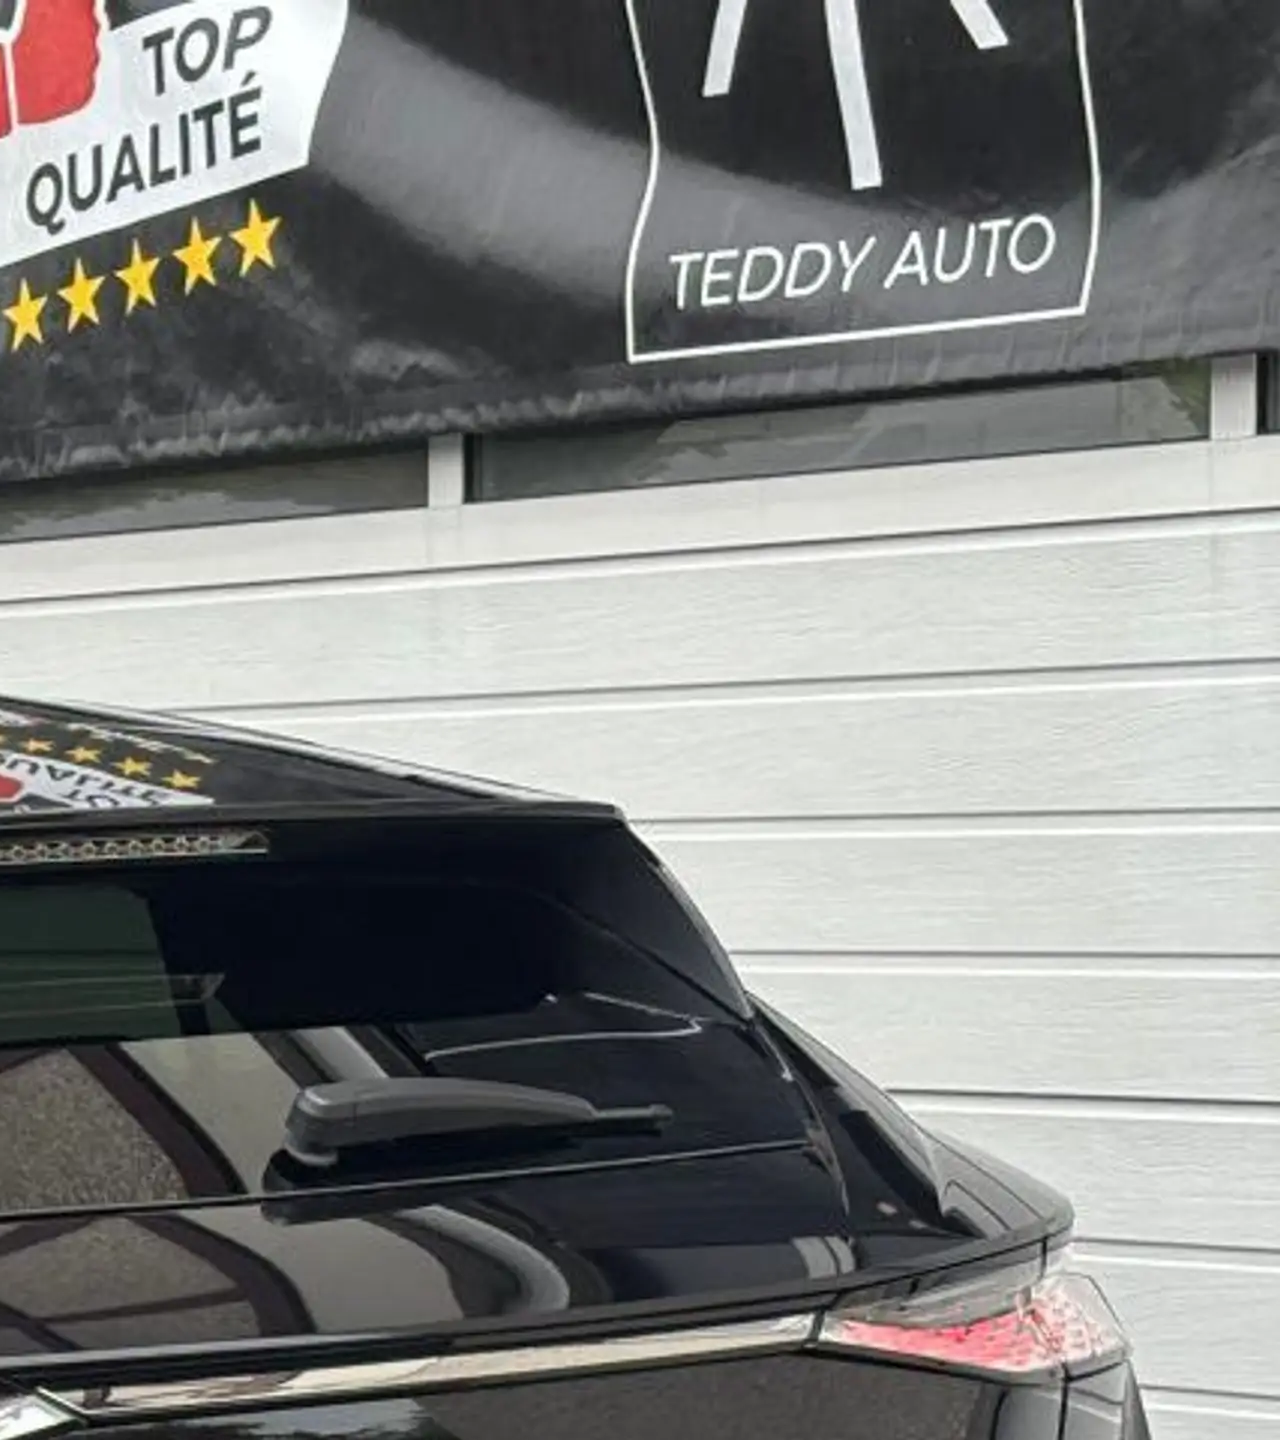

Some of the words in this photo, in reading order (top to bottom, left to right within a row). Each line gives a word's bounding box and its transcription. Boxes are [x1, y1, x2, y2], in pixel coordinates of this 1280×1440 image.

[141, 5, 272, 96] TOP
[25, 72, 263, 234] QUALITÉ
[669, 235, 877, 311] TEDDY
[884, 212, 1056, 290] AUTO
